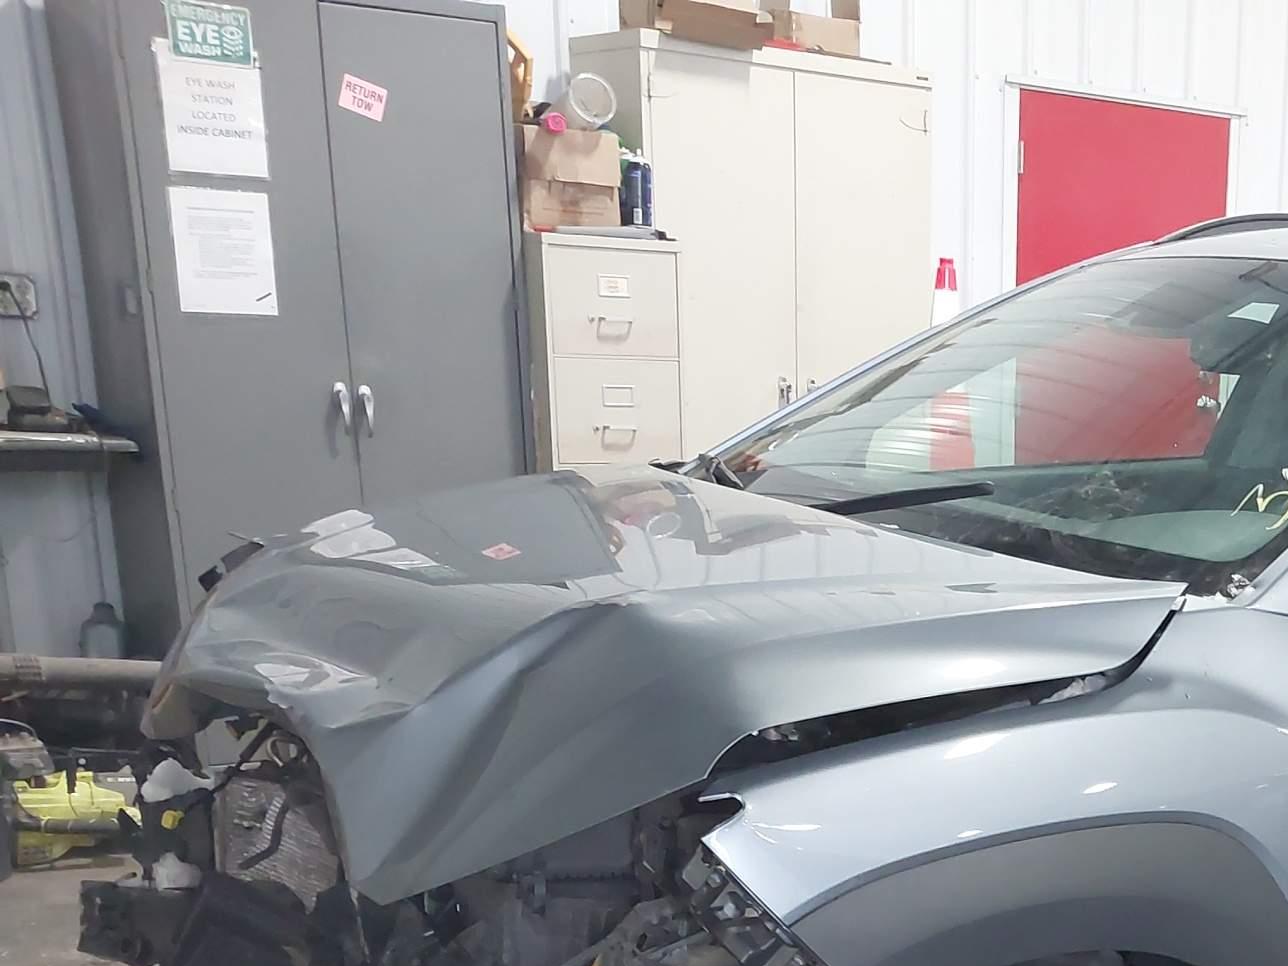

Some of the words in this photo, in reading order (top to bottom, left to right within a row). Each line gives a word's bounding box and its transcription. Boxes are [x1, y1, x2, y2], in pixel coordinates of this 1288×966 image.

[176, 20, 221, 45] EYE
[177, 41, 221, 56] WASH
[185, 77, 203, 88] EYE
[206, 79, 235, 89] WASH
[191, 94, 233, 105] STATION
[345, 81, 384, 104] RETURN
[352, 95, 374, 112] TOW
[191, 111, 236, 122] LOCATED
[177, 125, 209, 136] INSIDE
[211, 128, 252, 139] CABINET
